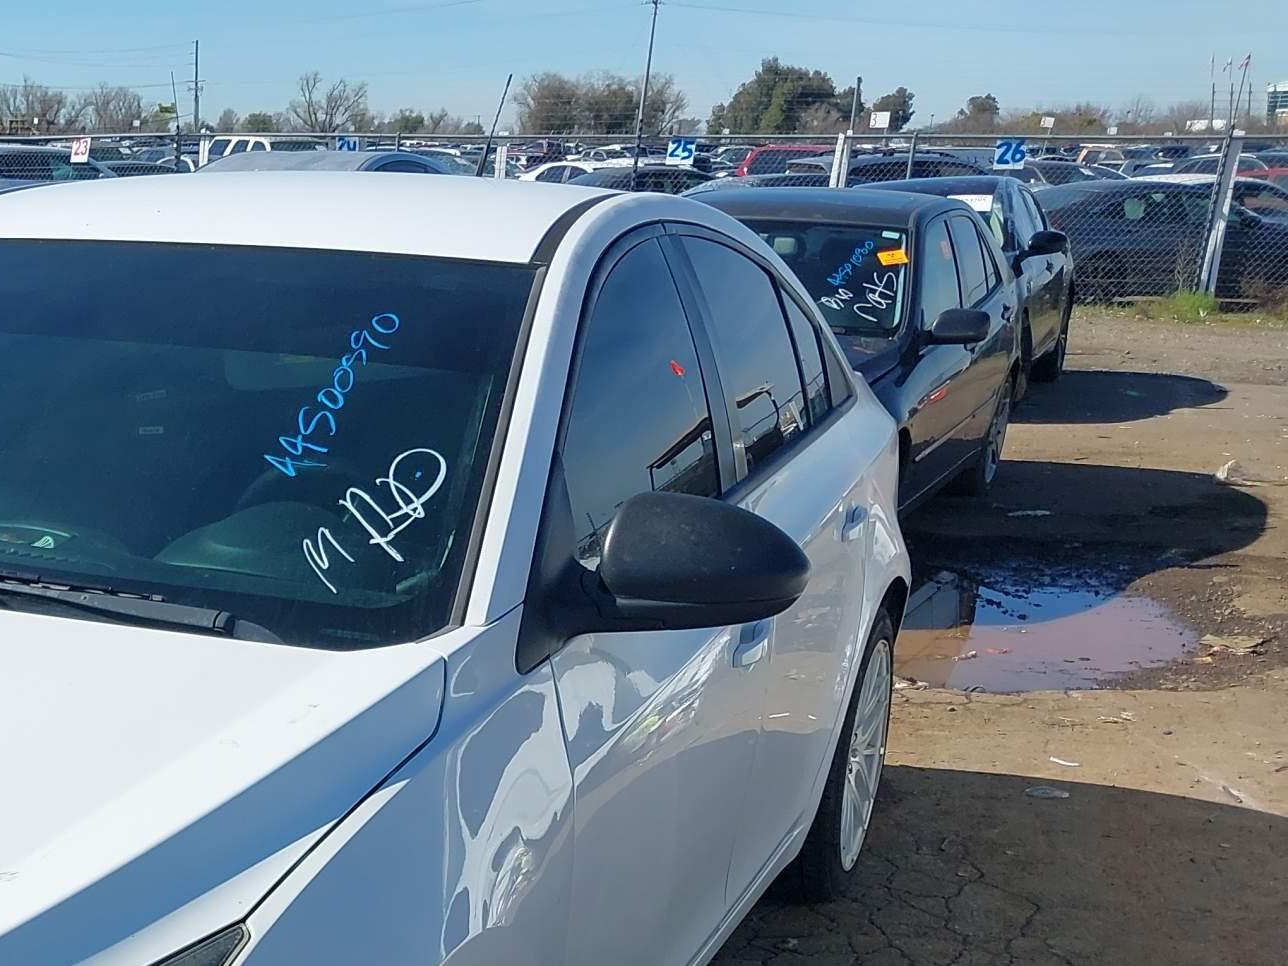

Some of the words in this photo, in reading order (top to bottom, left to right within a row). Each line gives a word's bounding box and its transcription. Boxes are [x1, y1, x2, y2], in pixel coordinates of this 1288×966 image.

[73, 139, 89, 156] 23
[668, 138, 696, 160] 25
[996, 140, 1026, 164] 26
[263, 313, 400, 477] 44500590
